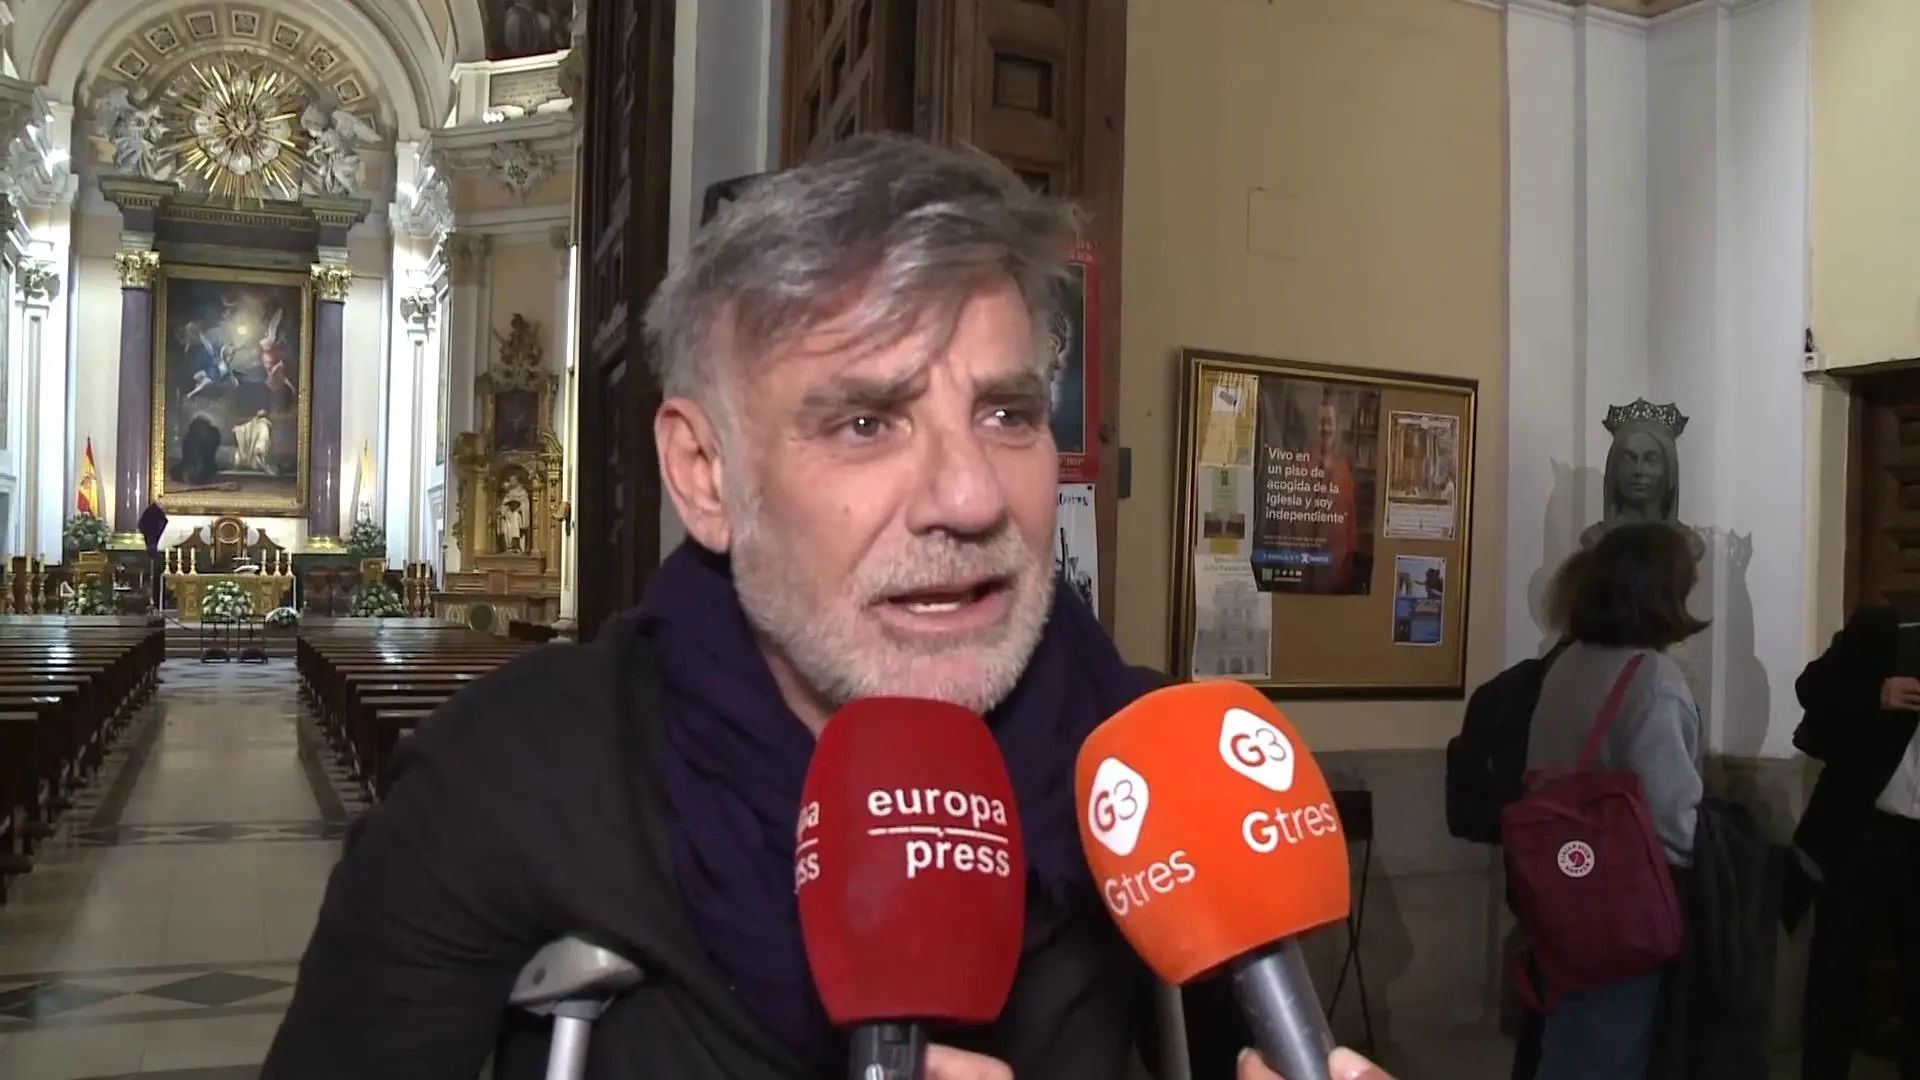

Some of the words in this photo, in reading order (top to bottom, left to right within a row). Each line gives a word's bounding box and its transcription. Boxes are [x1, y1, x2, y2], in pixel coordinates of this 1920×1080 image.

[1267, 464, 1282, 474] un
[1285, 465, 1308, 478] piso
[1310, 466, 1325, 478] de
[1295, 452, 1310, 462] en
[1266, 479, 1311, 493] acogida
[1313, 481, 1327, 493] de
[1329, 481, 1340, 494] la
[1266, 492, 1302, 507] Iglesia
[1305, 497, 1312, 509] y
[1314, 498, 1333, 511] soy
[1230, 727, 1287, 768] G3
[867, 788, 1007, 829] europa
[1094, 779, 1138, 832] G3
[1242, 801, 1337, 854] Gtres
[905, 839, 1010, 879] press
[1104, 850, 1196, 917] Gtres
